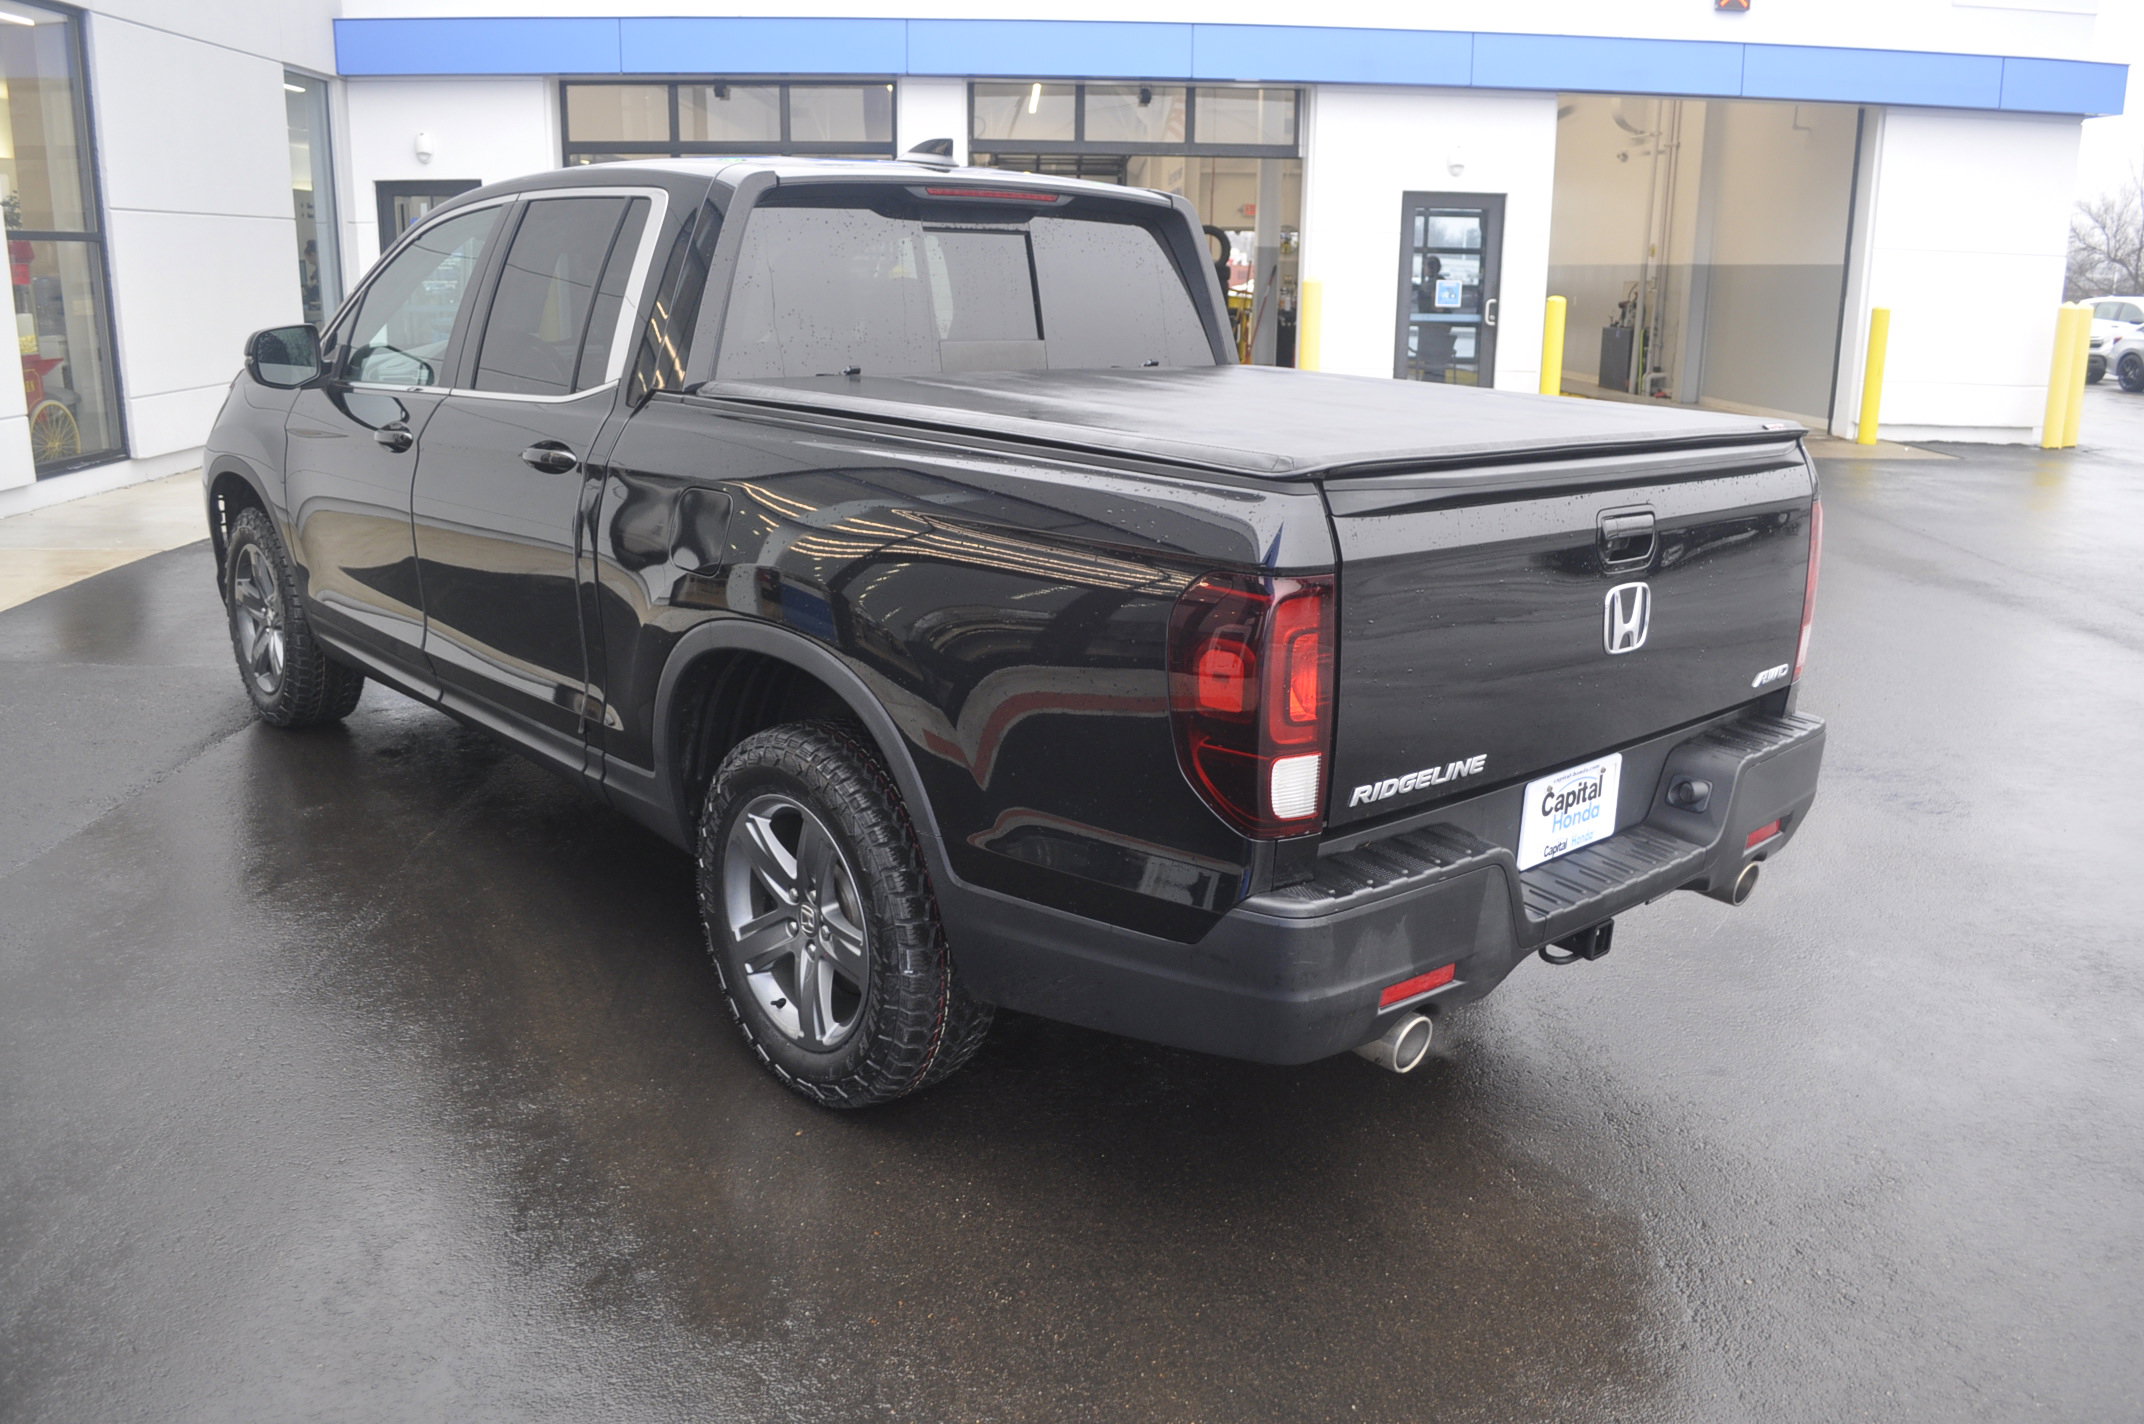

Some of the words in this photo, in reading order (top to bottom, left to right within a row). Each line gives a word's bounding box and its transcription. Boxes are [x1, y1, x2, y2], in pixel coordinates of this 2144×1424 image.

[1349, 754, 1487, 807] RIDGELINE
[1542, 775, 1603, 816] Capital
[1552, 803, 1600, 833] Honda
[1544, 838, 1568, 857] Capital
